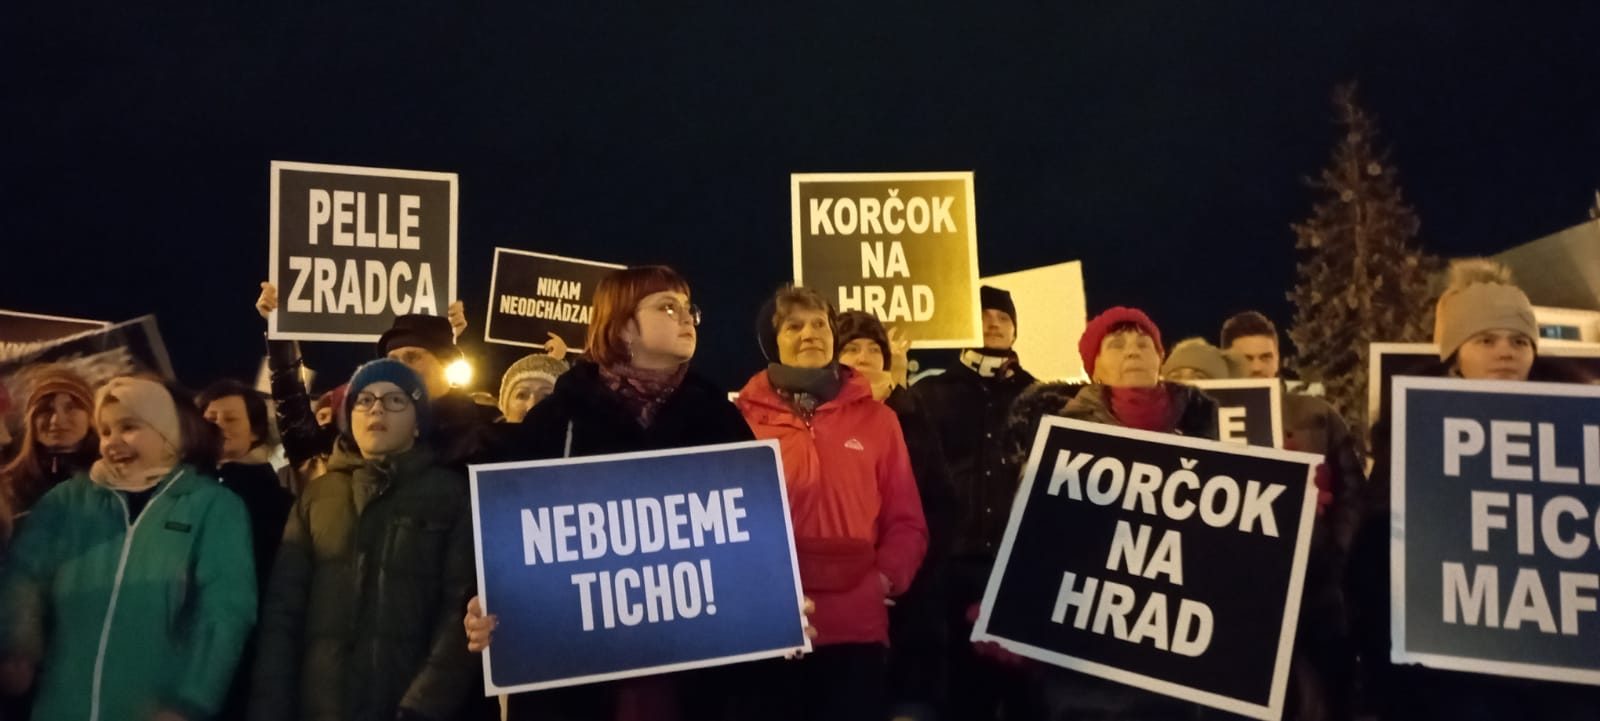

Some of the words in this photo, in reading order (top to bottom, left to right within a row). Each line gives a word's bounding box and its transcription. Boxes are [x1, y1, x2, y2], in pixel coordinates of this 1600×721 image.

[308, 188, 421, 250] PELLE
[809, 188, 958, 236] KORČOK
[286, 255, 439, 317] ZRADCA
[536, 276, 582, 301] NIKAM
[860, 241, 911, 279] NA
[838, 284, 936, 323] HRAD
[1046, 448, 1288, 538] KORČOK
[1470, 490, 1600, 560] FIC
[520, 487, 751, 566] NEBUDEME
[1105, 519, 1184, 586] NA
[571, 559, 718, 632] TICHO!
[1050, 570, 1215, 658] HRAD
